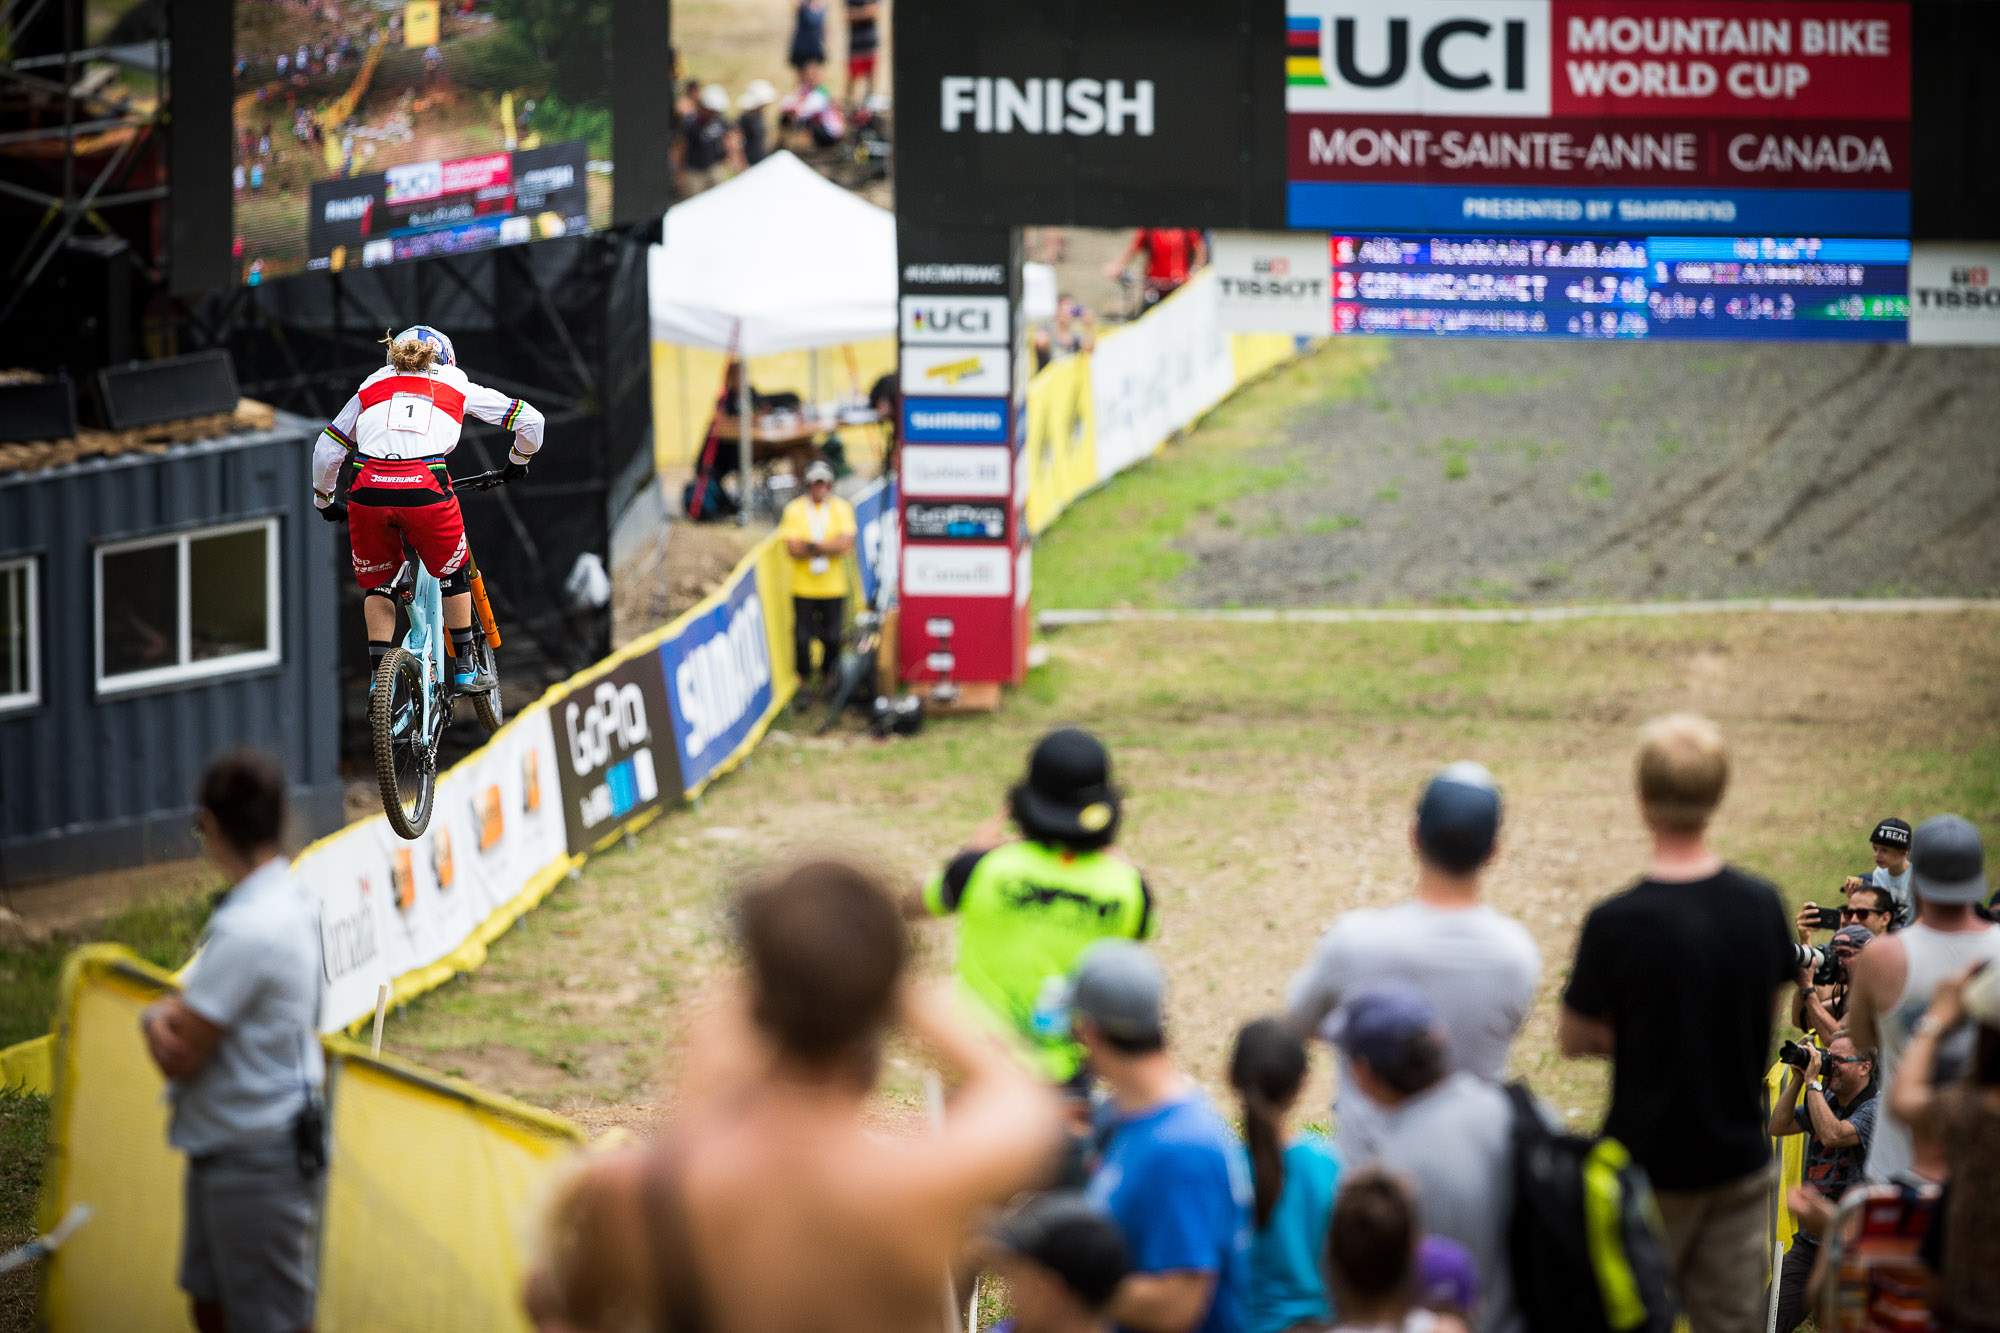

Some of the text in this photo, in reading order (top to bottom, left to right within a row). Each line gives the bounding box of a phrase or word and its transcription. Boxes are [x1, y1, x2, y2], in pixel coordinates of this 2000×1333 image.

[1334, 17, 1525, 91] UCI
[1567, 17, 1890, 57] MOUNTAIN BIKE
[1567, 62, 1810, 99] WORLD CUP
[941, 76, 1155, 137] FINISH
[1308, 128, 1892, 174] MONT-SAINTE-ANNE CANADA
[1463, 197, 1581, 221] PRESENTED
[1582, 199, 1614, 221] BY
[1219, 277, 1323, 299] TISSOT
[926, 308, 990, 332] UCI
[406, 404, 414, 418] 1
[566, 681, 649, 777] GoPro
[1885, 830, 1908, 843] REAL
